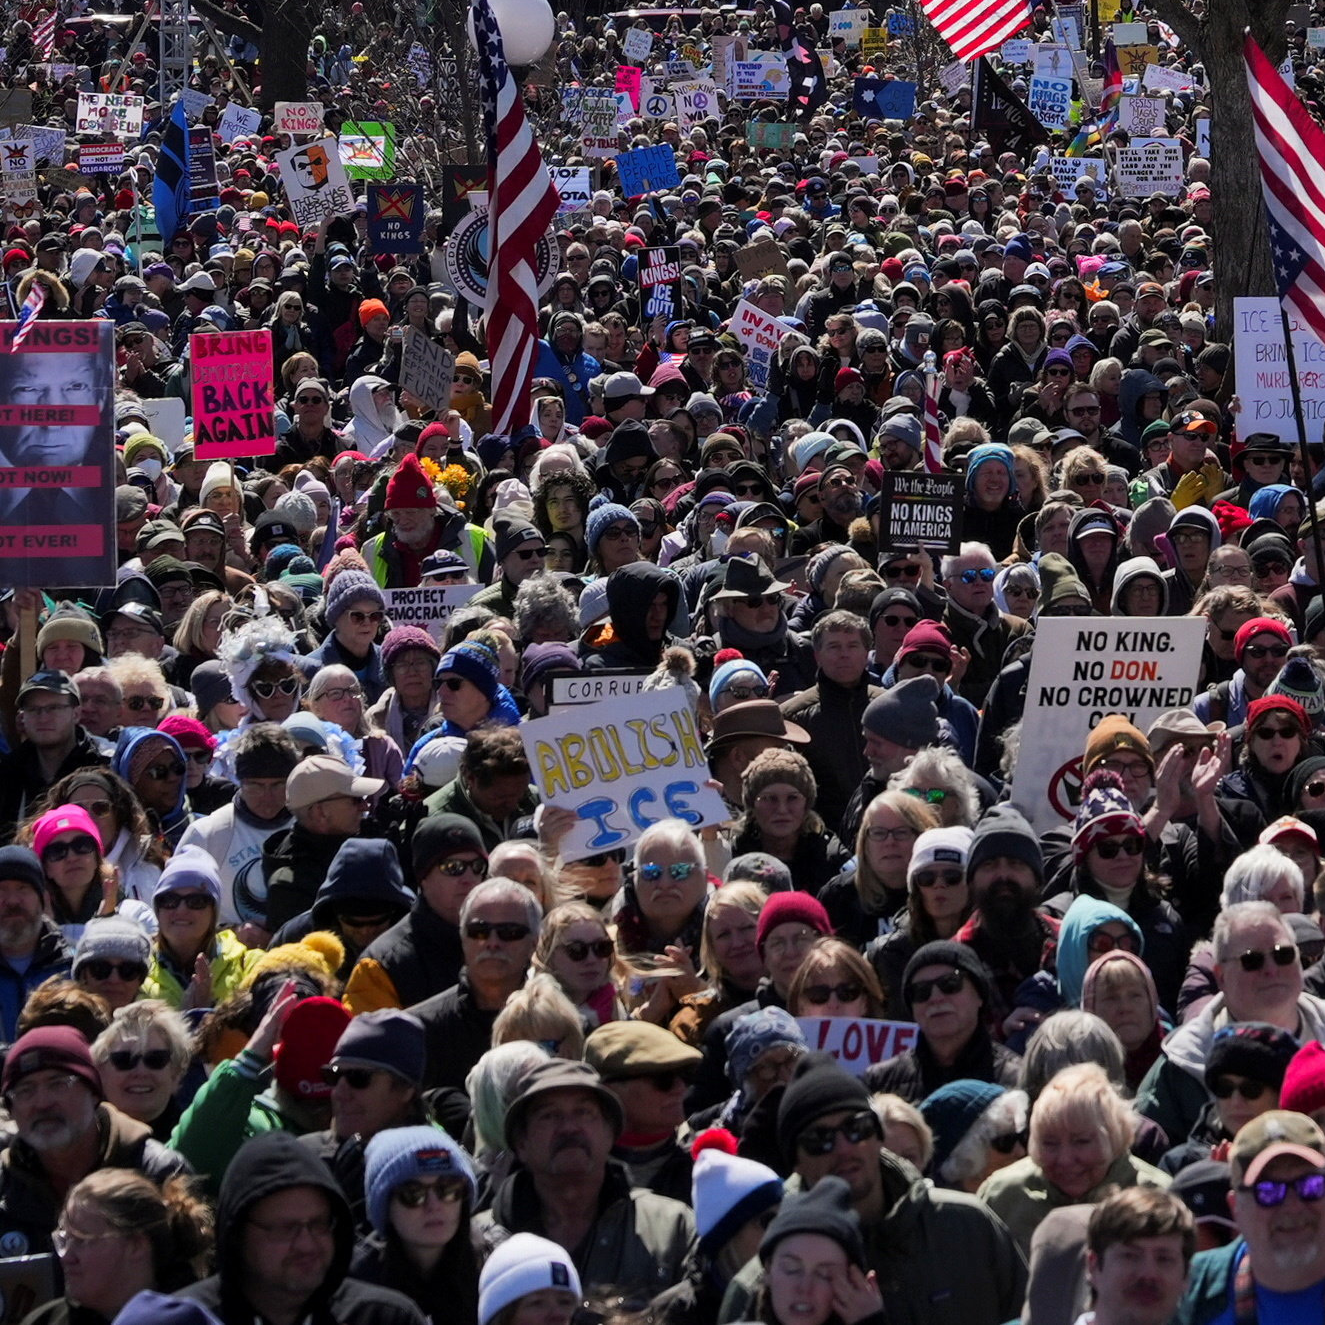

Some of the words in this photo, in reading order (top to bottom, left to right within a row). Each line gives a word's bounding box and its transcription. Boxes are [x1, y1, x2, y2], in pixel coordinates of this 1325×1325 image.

[1034, 79, 1068, 92] NO
[1033, 89, 1067, 104] KINGS
[286, 108, 306, 117] NO
[281, 118, 318, 130] KINGS
[80, 146, 124, 155] DEMOCRACY
[82, 165, 123, 173] OLIGARCHY
[293, 195, 322, 209] THIS
[324, 185, 346, 199] HAS
[296, 195, 350, 218] HAPPENED
[299, 205, 350, 225] BEFORE
[380, 231, 410, 240] KINGS
[388, 222, 400, 230] NO
[650, 249, 666, 265] NO
[641, 263, 680, 285] KINGS!
[653, 283, 673, 301] ICE
[647, 296, 675, 319] OUT!
[195, 331, 267, 360] BRING
[203, 381, 274, 415] BACK
[21, 409, 74, 423] HERE!
[196, 413, 276, 445] AGAIN
[24, 470, 72, 483] NOW!
[894, 477, 910, 493] We
[910, 477, 924, 493] the
[924, 479, 955, 497] People
[891, 503, 910, 521] NO
[912, 504, 953, 523] KINGS
[890, 521, 901, 535] IN
[903, 523, 952, 539] AMERICA
[24, 535, 78, 547] EVER!
[392, 589, 446, 605] PROTECT
[1076, 631, 1108, 652] NO
[1115, 631, 1176, 652] KING.
[1072, 661, 1104, 681] NO
[1110, 661, 1163, 681] DON.
[1039, 687, 1070, 707] NO
[1077, 687, 1194, 707] CROWNED
[534, 709, 708, 800] ABOLISH
[575, 779, 704, 850] ICE
[816, 1019, 915, 1065] LOVE
